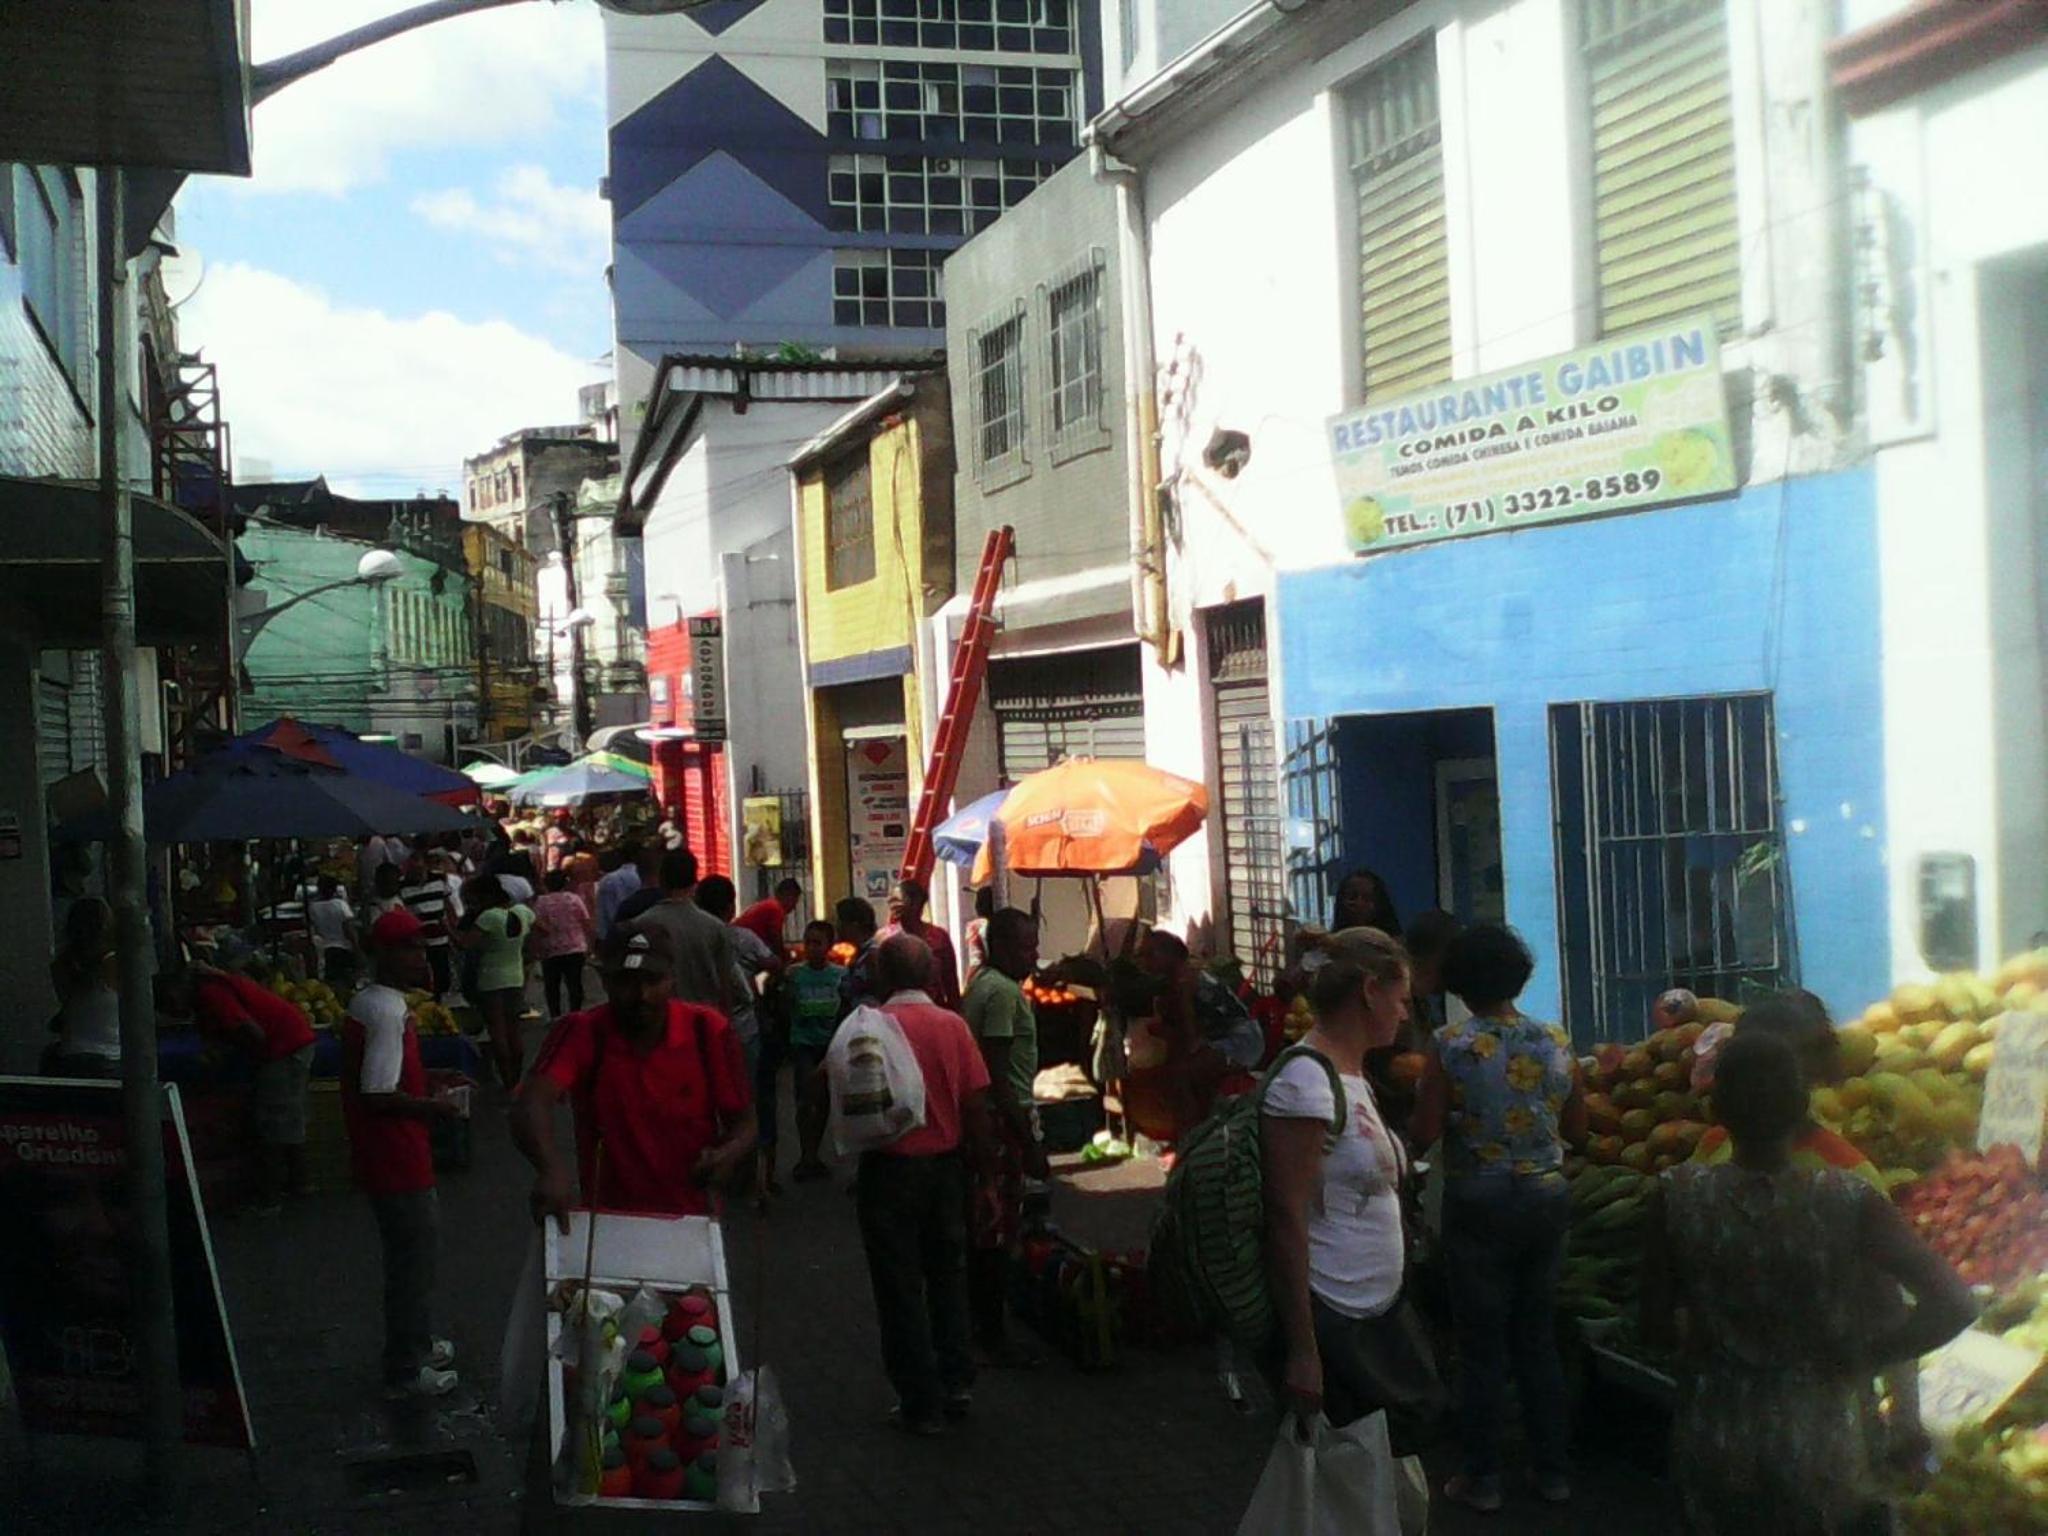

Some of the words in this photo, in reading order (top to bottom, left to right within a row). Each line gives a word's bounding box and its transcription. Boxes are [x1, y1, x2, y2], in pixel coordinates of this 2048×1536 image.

[1333, 371, 1545, 452] RESTAURANTE
[1557, 330, 1705, 396] GAIBIN
[1400, 423, 1506, 457] COMIDA
[1516, 416, 1536, 432] A
[1546, 396, 1620, 425] KILO
[1427, 452, 1470, 470] COMIDA
[1534, 426, 1584, 447] COMIDA
[1384, 513, 1437, 535] TEL.:
[1445, 499, 1495, 529] (71)
[1504, 468, 1661, 515] 3322-8589
[0, 1121, 98, 1144] parelho
